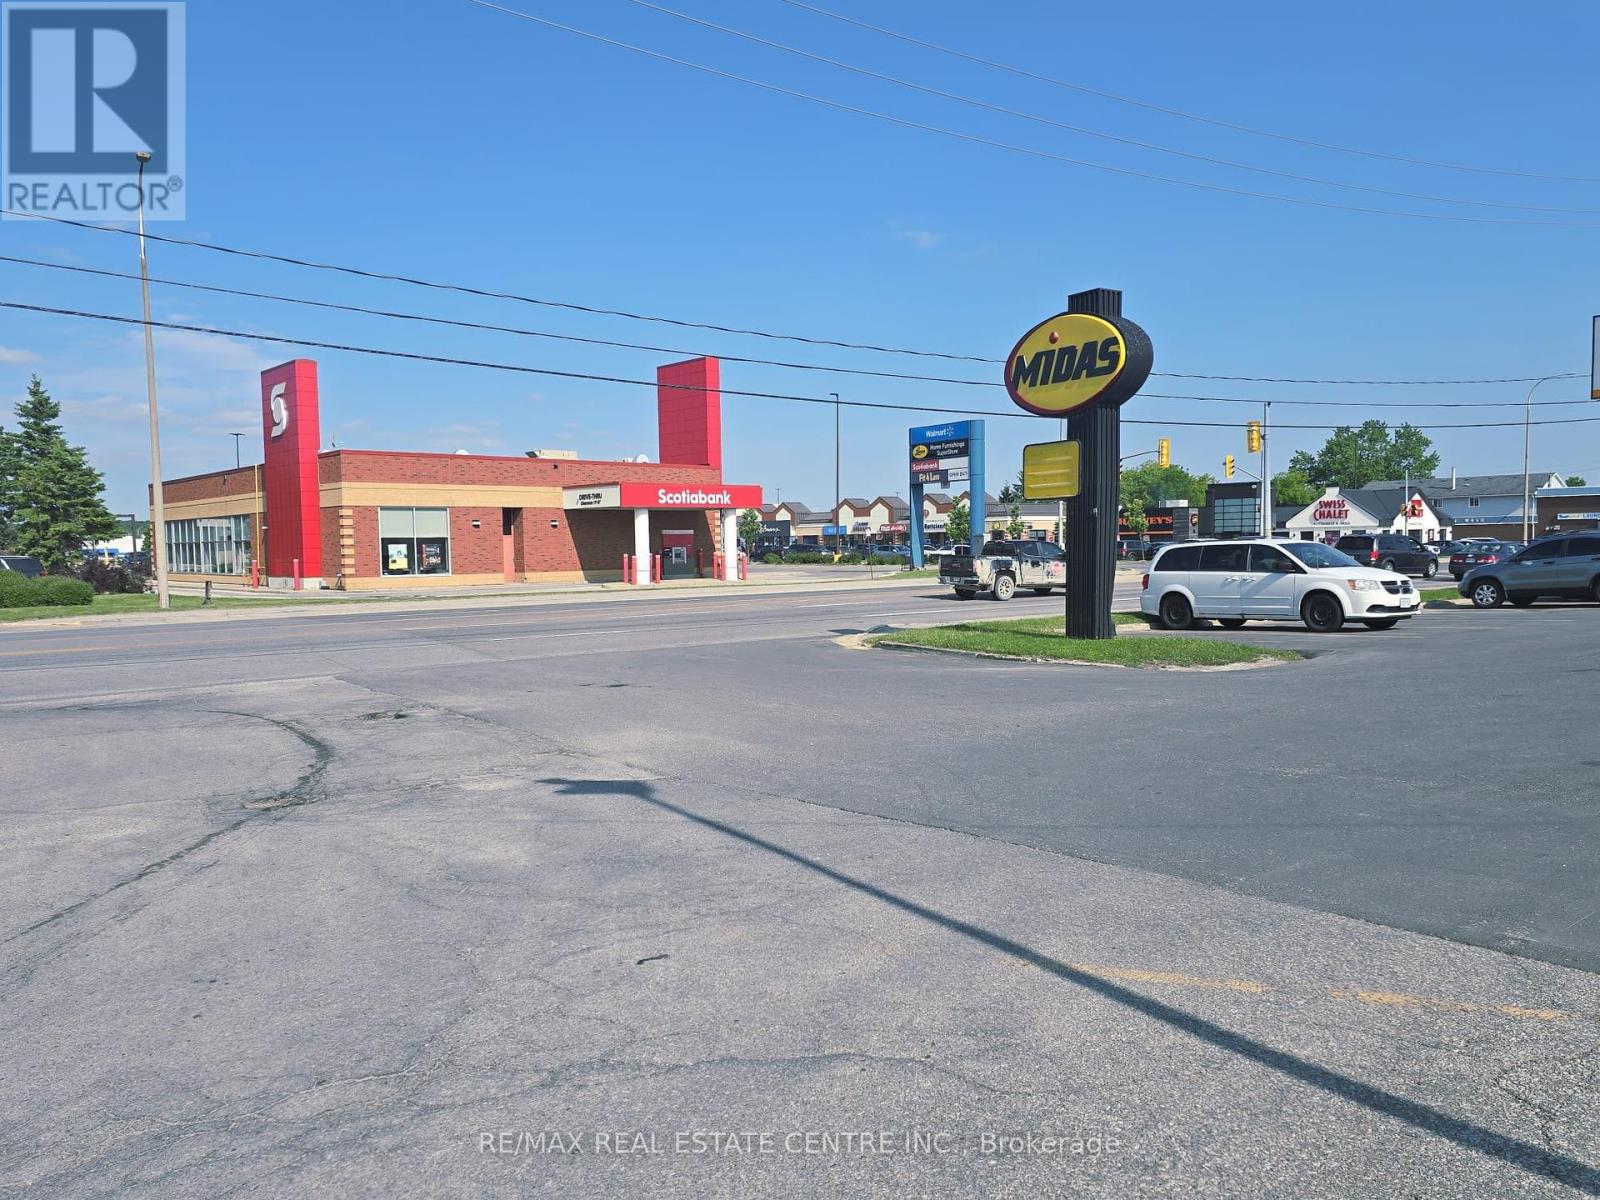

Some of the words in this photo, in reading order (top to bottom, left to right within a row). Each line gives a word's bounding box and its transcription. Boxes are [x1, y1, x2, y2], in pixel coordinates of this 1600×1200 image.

[1012, 336, 1121, 391] MIDAS
[926, 429, 946, 438] Walmart
[912, 462, 938, 471] Scotiabank
[658, 488, 731, 505] Scotiabank
[1318, 499, 1346, 509] SWISS
[1313, 509, 1350, 521] CHALET
